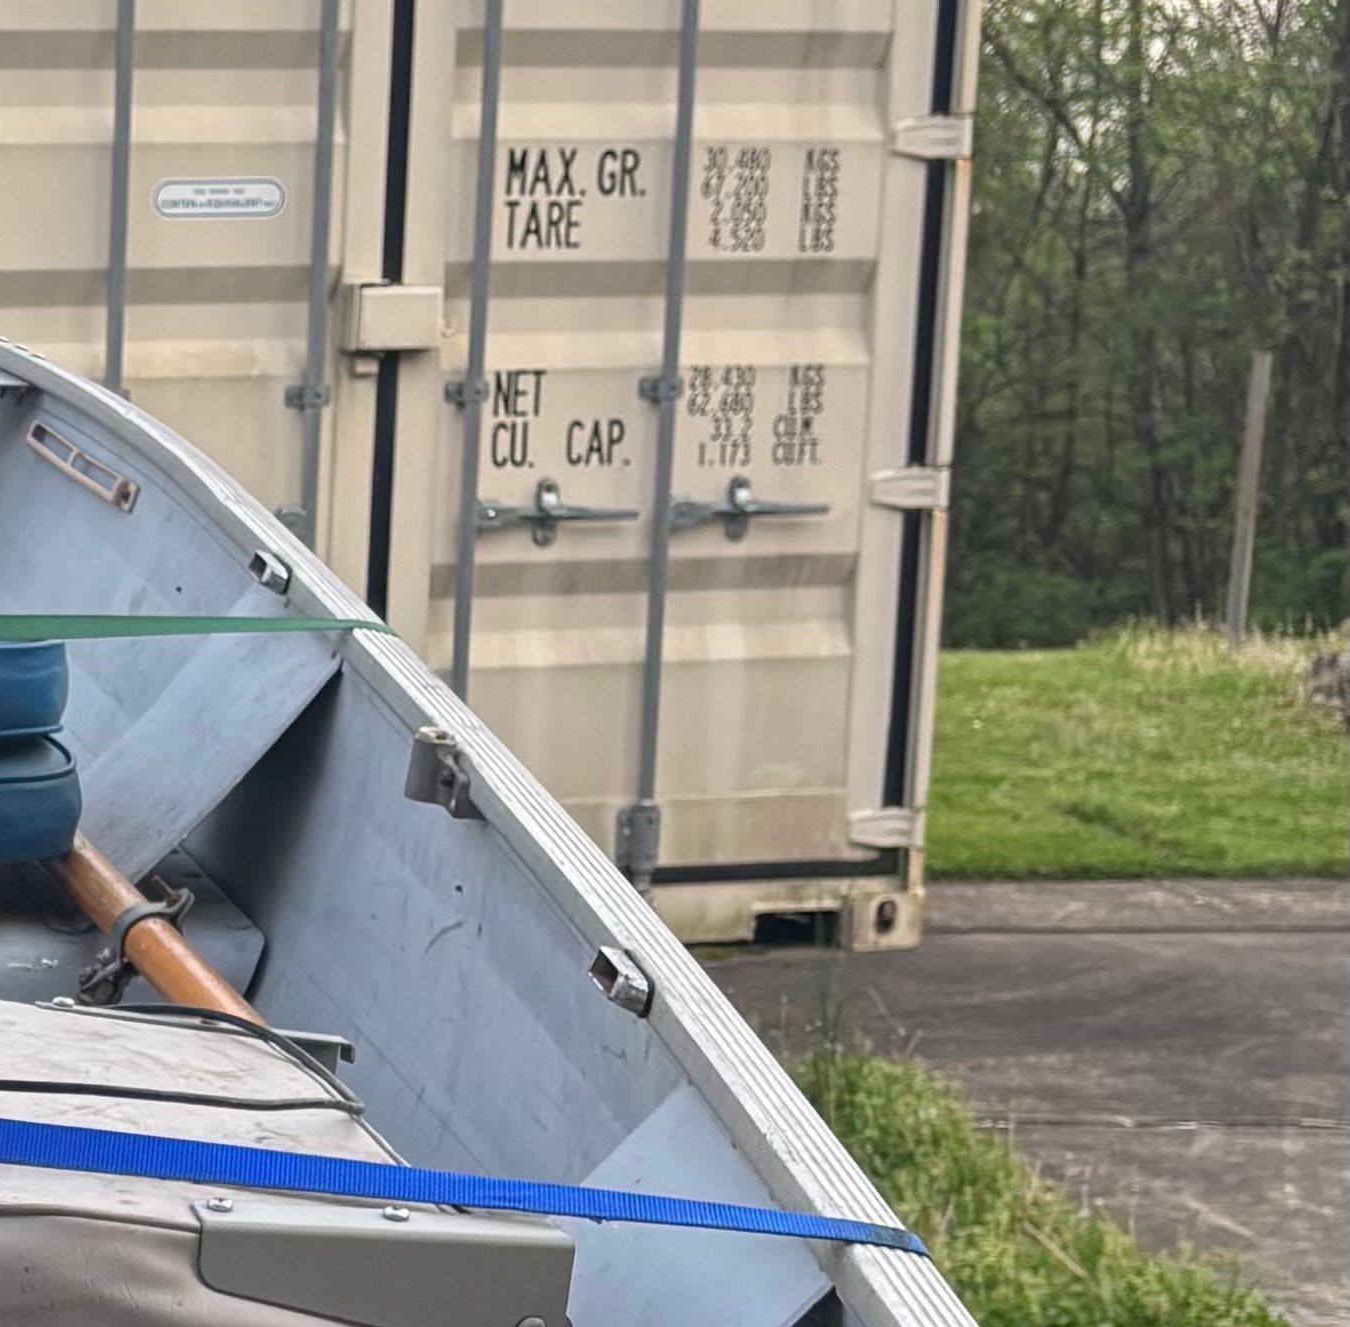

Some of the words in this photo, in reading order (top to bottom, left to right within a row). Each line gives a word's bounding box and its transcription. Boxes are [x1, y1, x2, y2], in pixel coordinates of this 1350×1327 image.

[505, 147, 587, 197] MAX.
[596, 147, 647, 198] GR.
[804, 147, 841, 173] KGS
[802, 173, 839, 199] LBS
[504, 199, 584, 249] TARE
[800, 199, 837, 224] KGS
[798, 225, 835, 252] LBS
[789, 363, 825, 388] KGS
[492, 369, 547, 417] NET
[787, 388, 824, 415] LBS
[491, 419, 535, 469] CU.
[566, 417, 632, 467] CAP.
